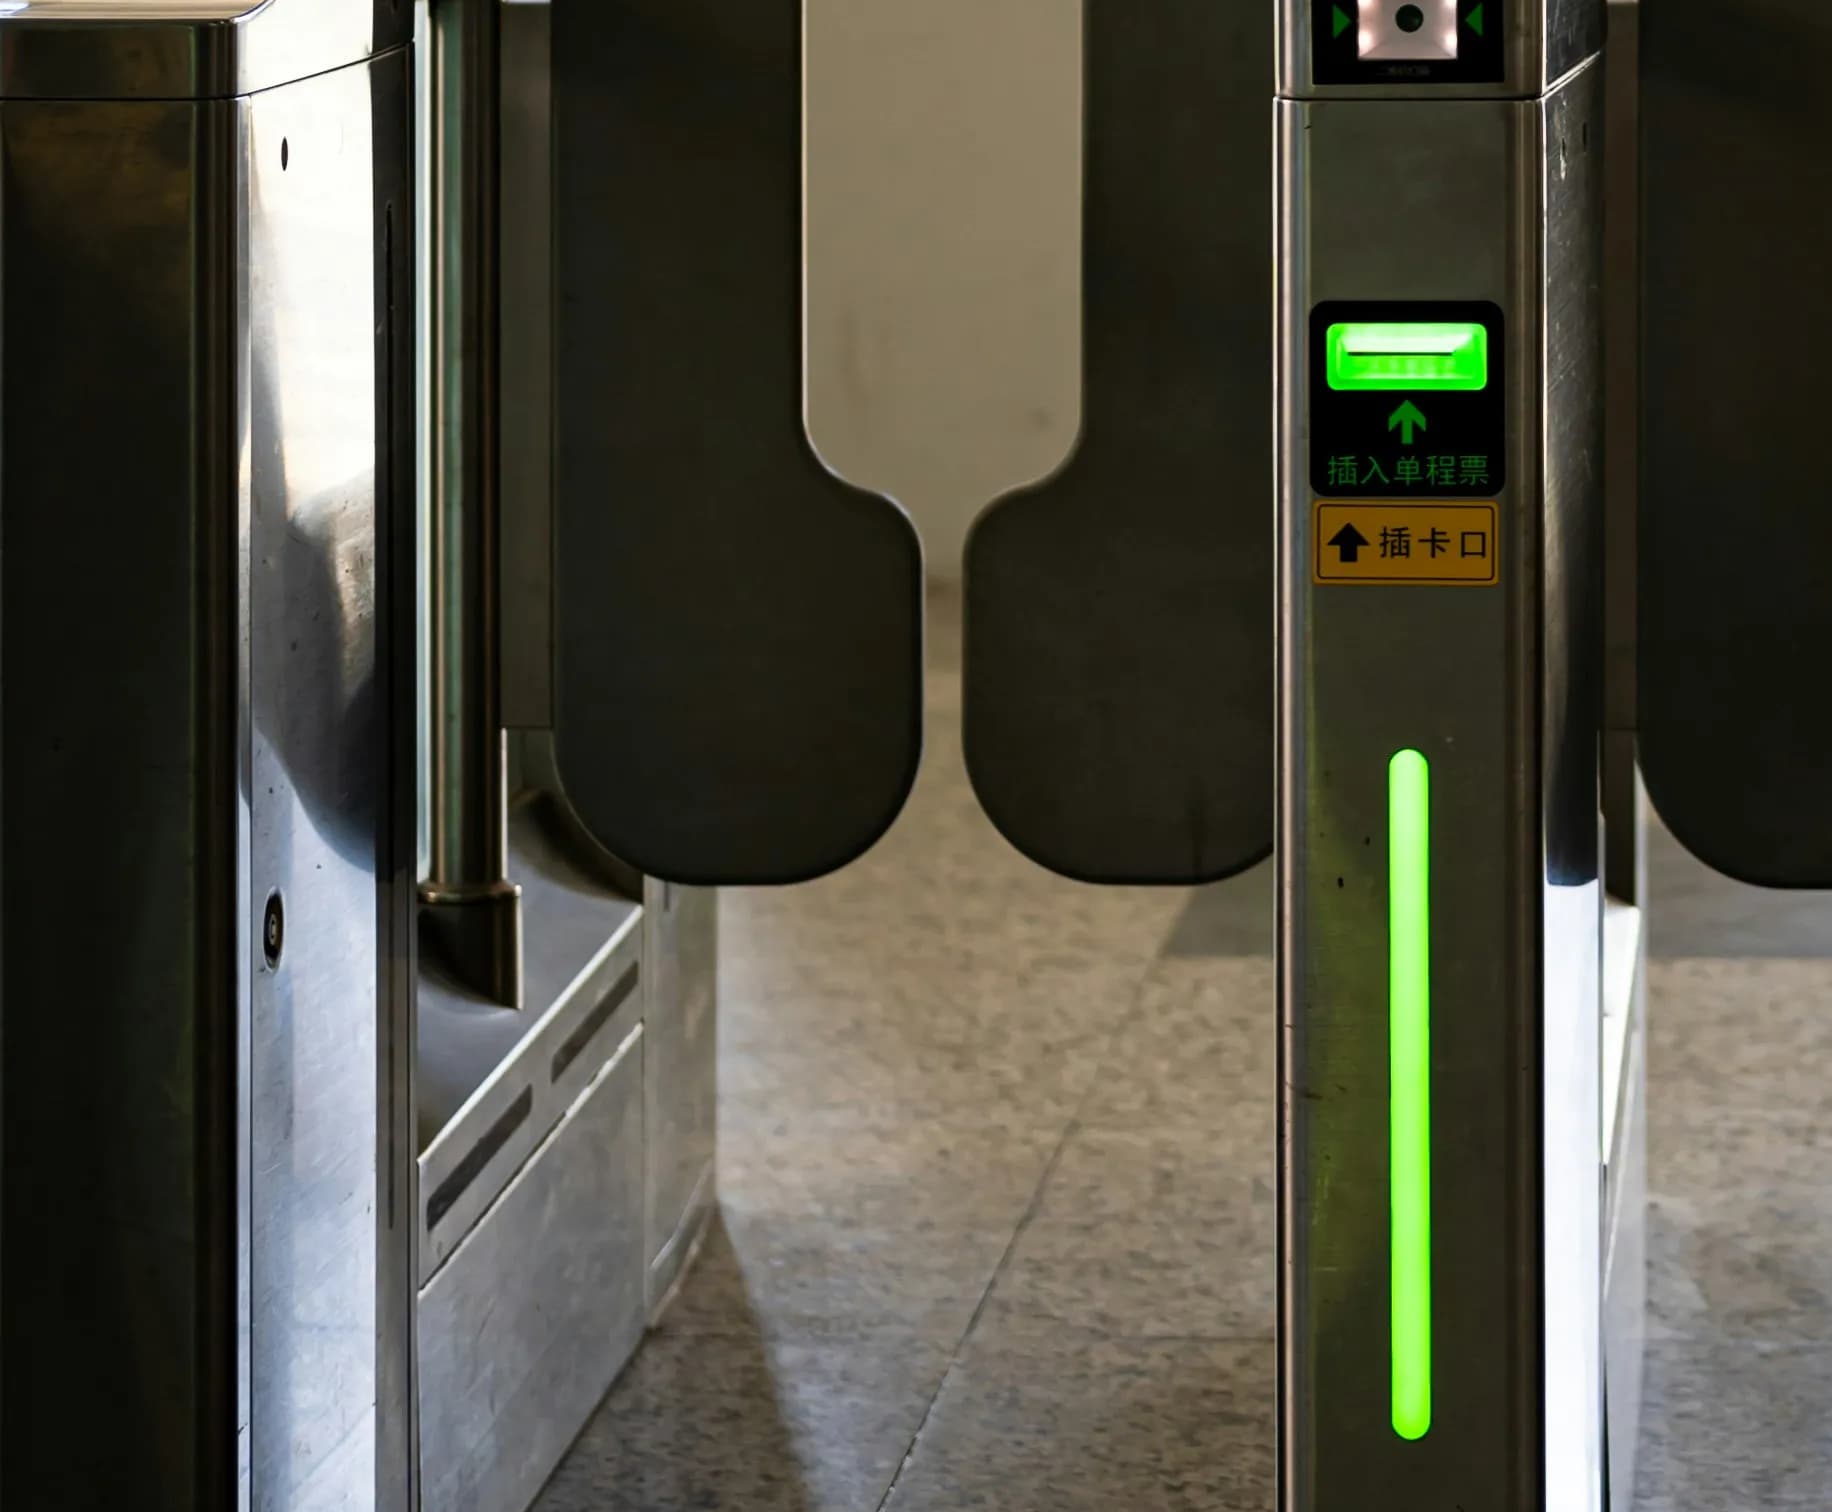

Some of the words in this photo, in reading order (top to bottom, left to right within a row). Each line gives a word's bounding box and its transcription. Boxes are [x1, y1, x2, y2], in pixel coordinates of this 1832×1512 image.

[1328, 455, 1489, 486] 插入单程票
[1379, 526, 1487, 559] 插卡口
